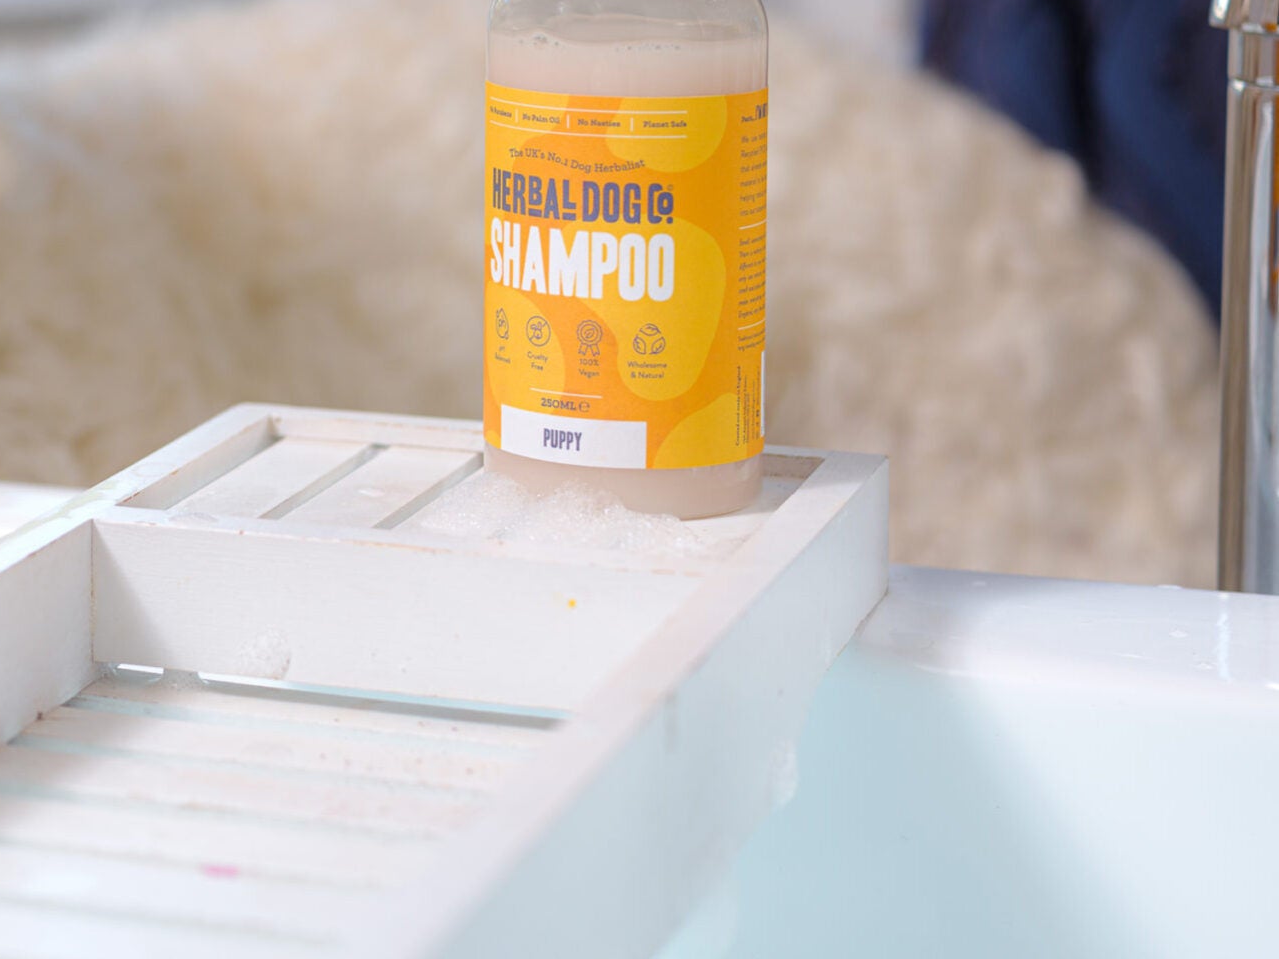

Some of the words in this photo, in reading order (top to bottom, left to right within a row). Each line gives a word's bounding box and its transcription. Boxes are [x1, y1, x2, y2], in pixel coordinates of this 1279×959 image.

[577, 118, 588, 126] No
[590, 119, 621, 127] Nasties
[643, 120, 669, 128] Planet
[671, 120, 687, 128] Safe
[509, 148, 523, 158] The
[525, 148, 545, 159] UK's
[548, 152, 567, 166] No.1
[570, 160, 591, 174] Dog
[595, 160, 645, 173] Herbalist
[493, 167, 577, 221] HERBAL
[582, 180, 641, 224] DOG
[490, 216, 675, 302] SHAMPOO
[527, 351, 548, 363] Cruelty
[579, 358, 599, 366] 100%
[531, 362, 543, 370] Free
[627, 361, 667, 369] Wholesome
[579, 369, 599, 378] Vegan
[541, 398, 577, 411] 250ML
[543, 428, 582, 451] PUPPY
